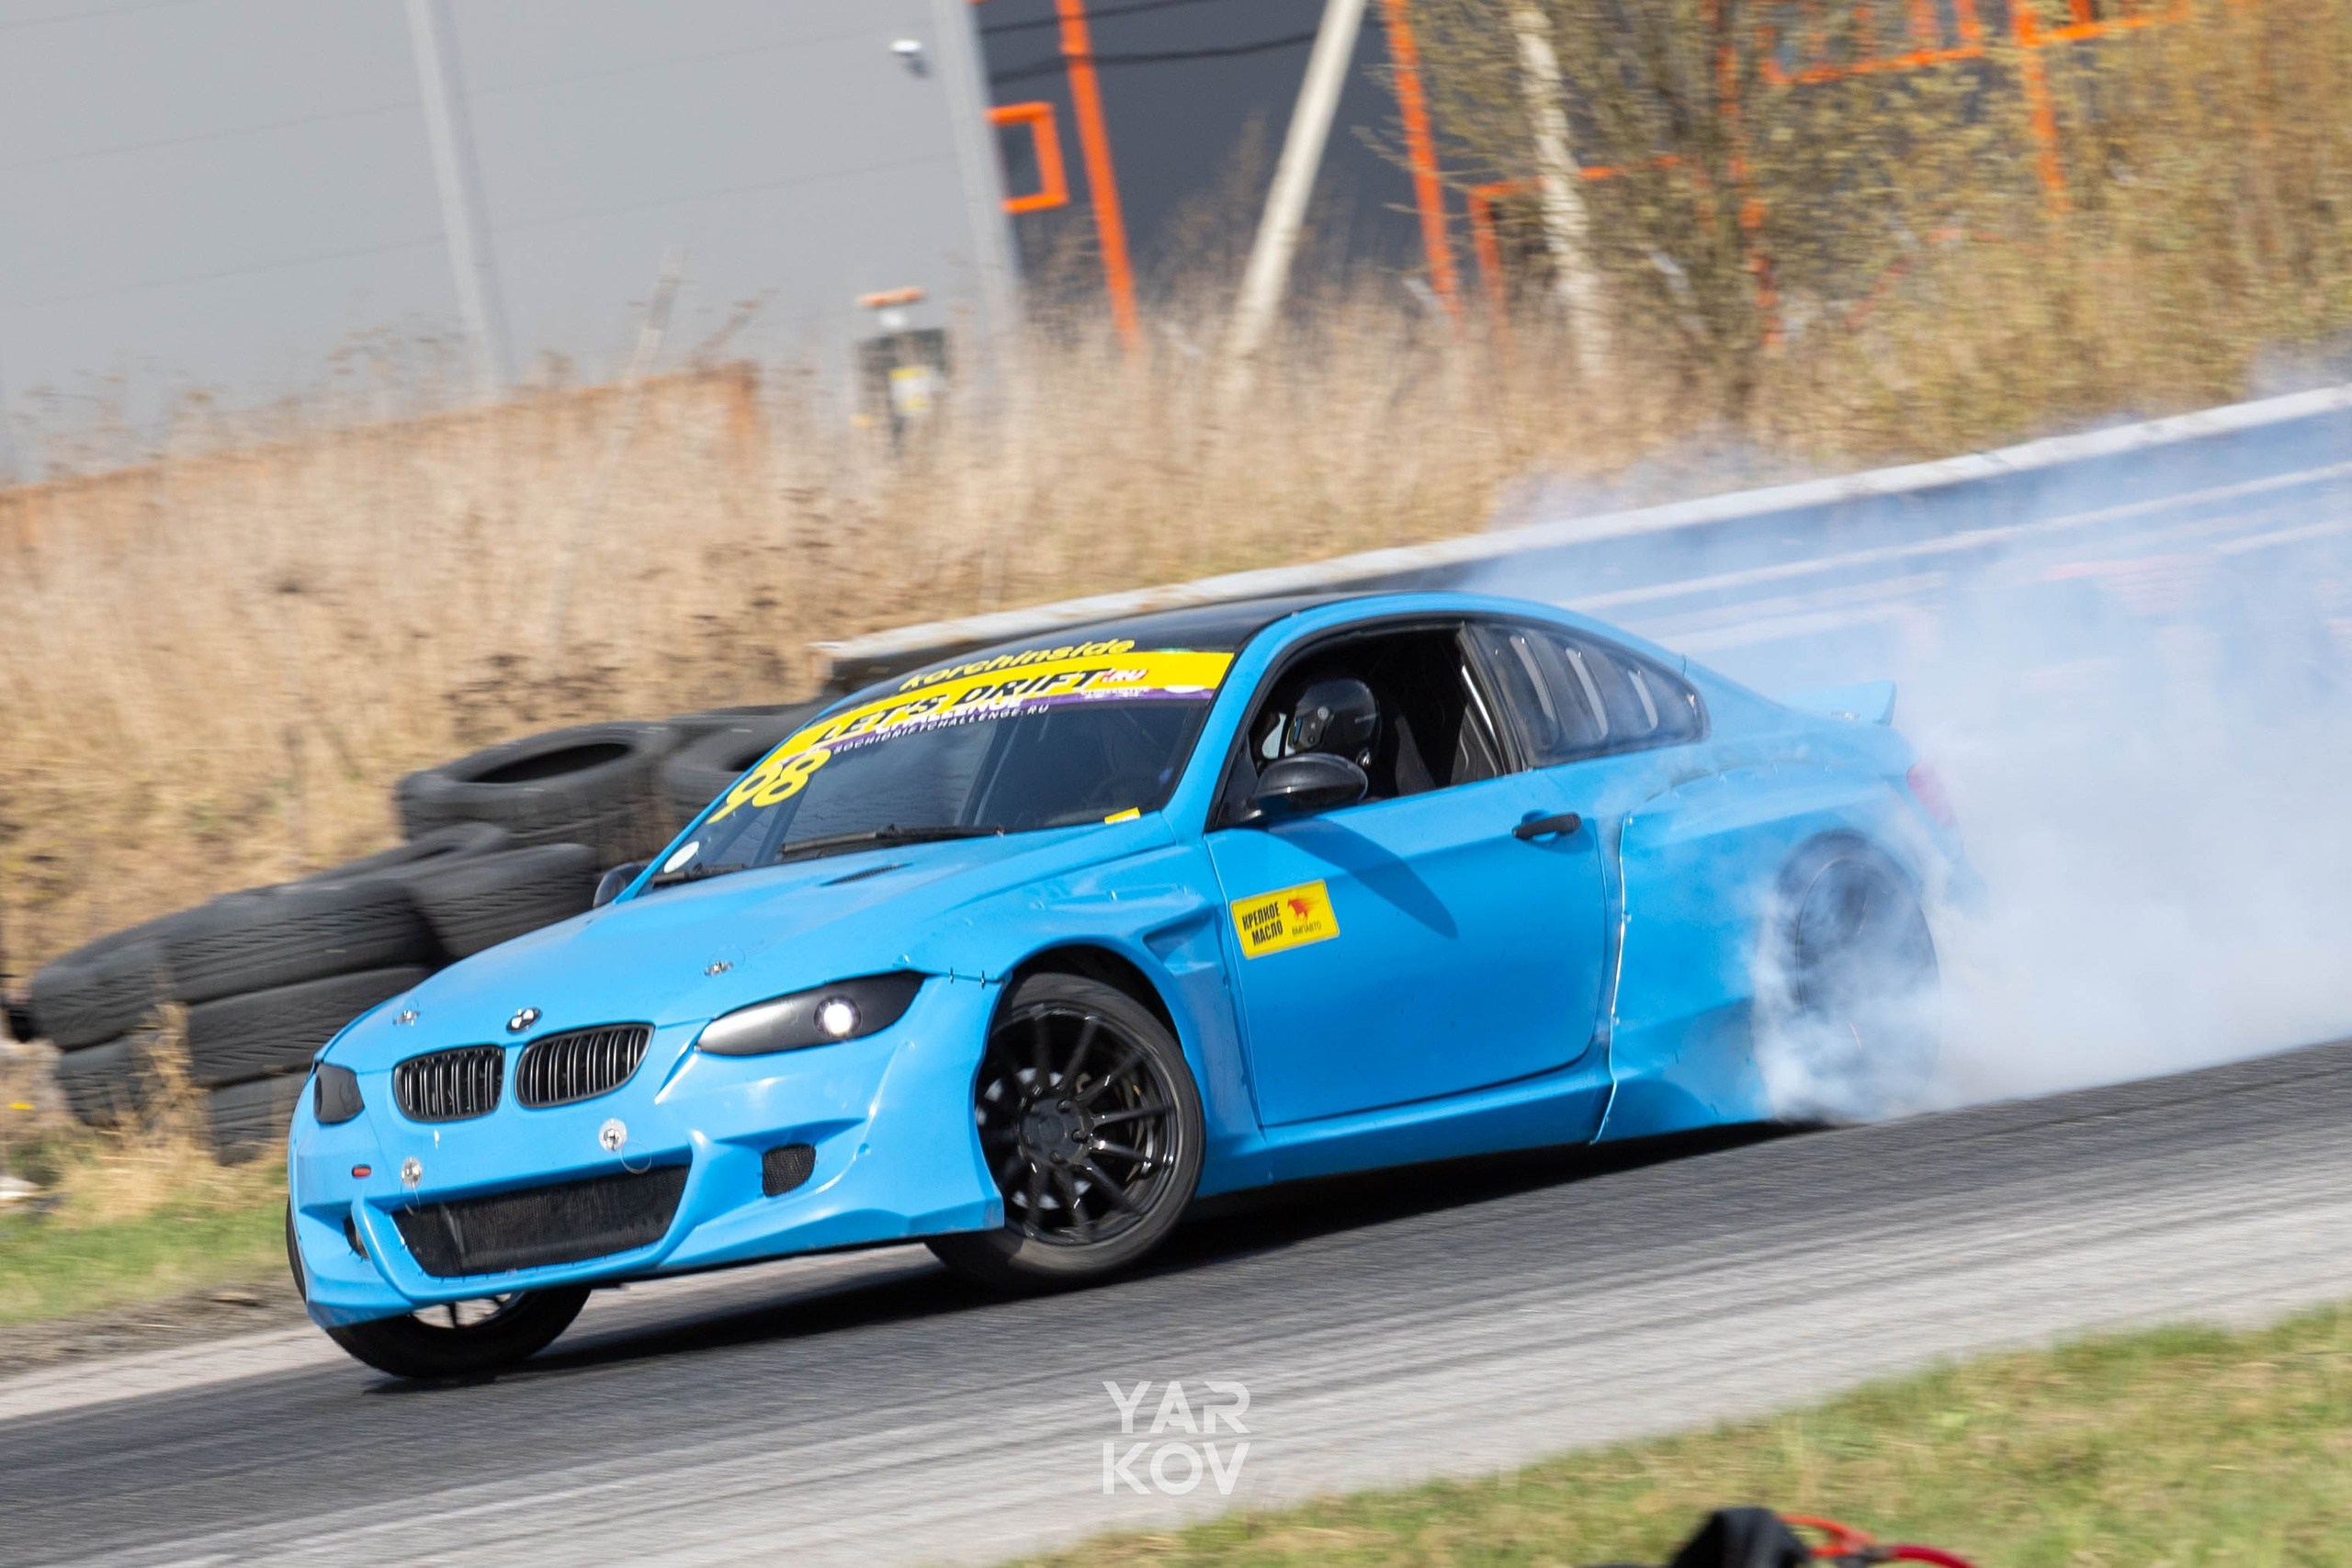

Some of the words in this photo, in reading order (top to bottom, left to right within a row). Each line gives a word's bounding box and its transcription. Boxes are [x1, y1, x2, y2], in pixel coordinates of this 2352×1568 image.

[706, 749, 831, 824] 98
[1242, 901, 1281, 931] КРЕПКОЕ
[1251, 919, 1283, 946] МАСЛО
